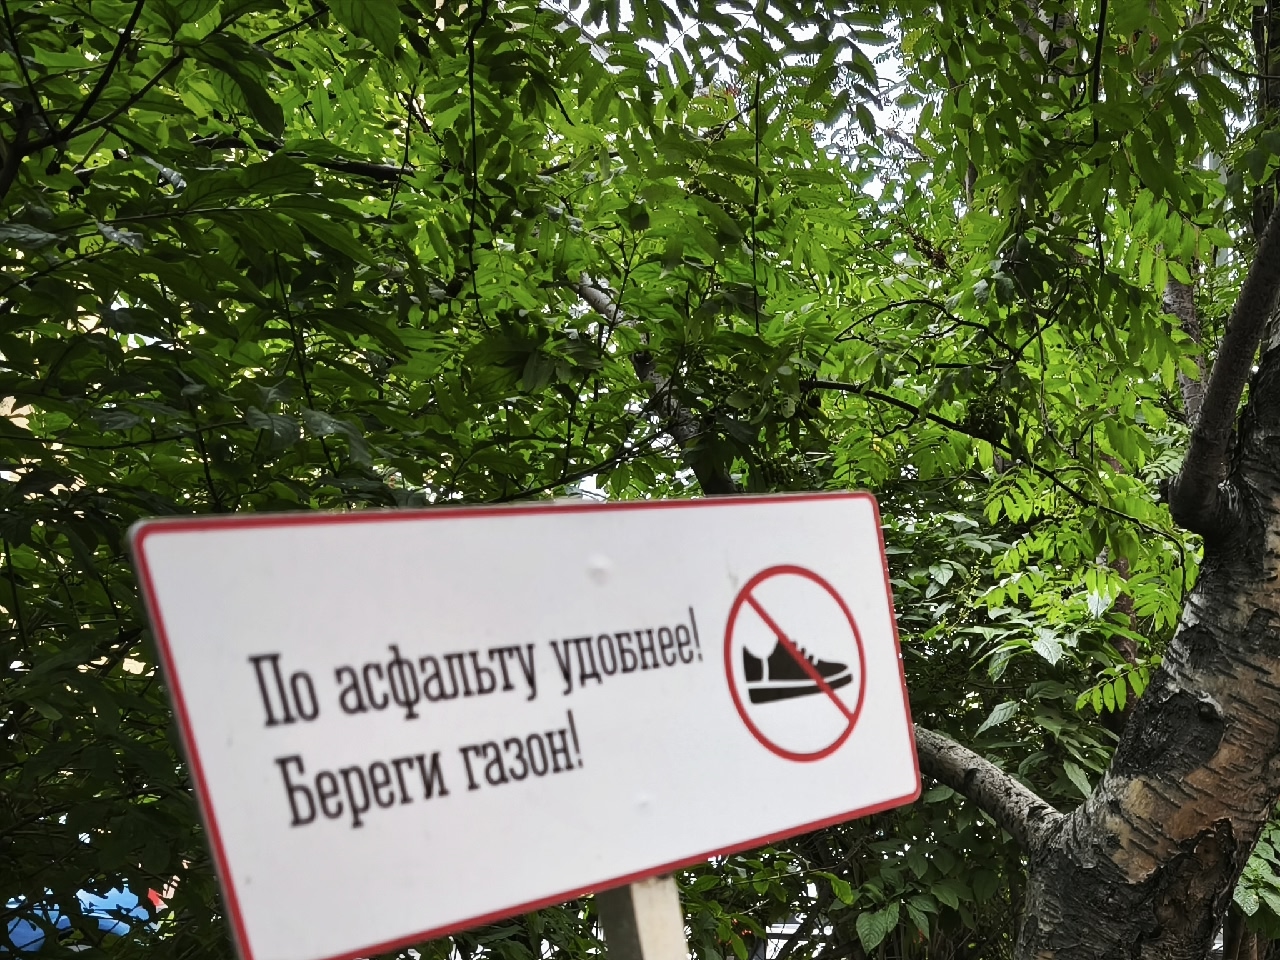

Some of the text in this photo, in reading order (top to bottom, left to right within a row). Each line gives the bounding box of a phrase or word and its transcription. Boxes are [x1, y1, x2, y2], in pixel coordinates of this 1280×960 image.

[249, 606, 703, 728] По асфальту удобнее!
[274, 709, 584, 828] Береги газон!
